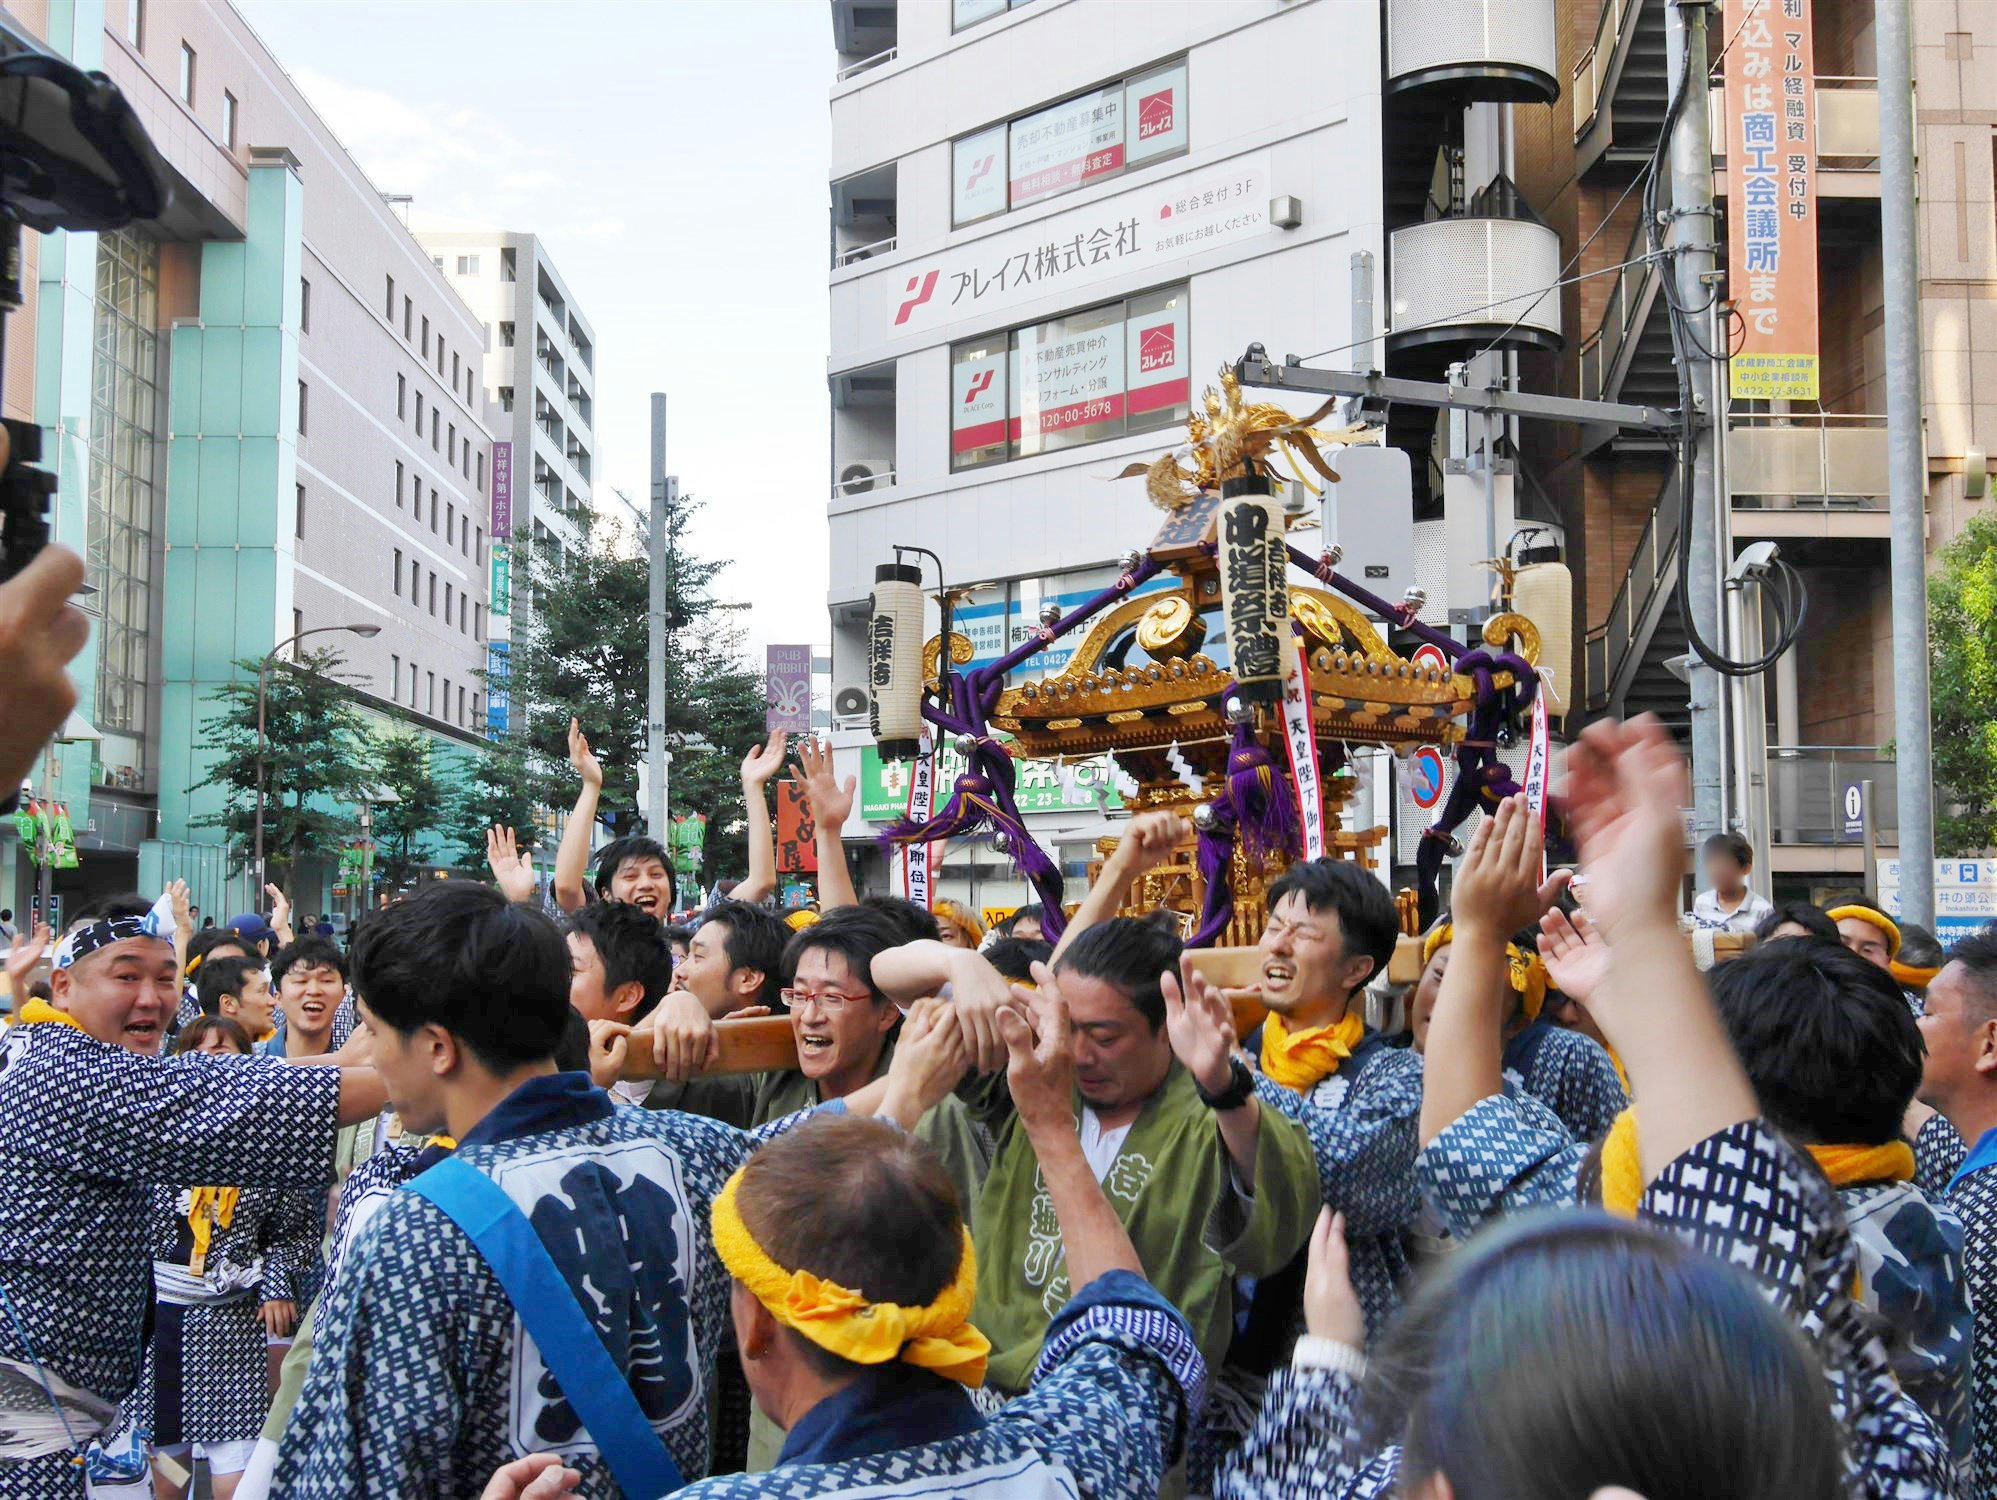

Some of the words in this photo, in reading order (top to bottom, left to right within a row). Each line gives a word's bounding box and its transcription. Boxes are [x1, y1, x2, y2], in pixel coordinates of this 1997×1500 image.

[1784, 32, 1806, 142] マル経融資
[1175, 186, 1229, 215] 総合受付
[1236, 179, 1253, 197] 3F
[1787, 155, 1807, 220] 受付中
[1155, 212, 1263, 252] お気軽にお越しください
[951, 217, 1141, 306] プレイス株式会社
[1037, 335, 1108, 363] 不動産売買仲介
[1141, 350, 1173, 369] プレイス
[1041, 402, 1111, 428] 120-00-5678
[496, 446, 508, 531] 吉祥寺第一ホテル
[768, 662, 809, 674] RABBIT
[777, 650, 801, 660] PUB
[873, 614, 894, 686] 吉祥寺
[1025, 658, 1041, 667] TEL
[863, 803, 891, 812] INAGAKI
[891, 802, 908, 811] PHAR
[909, 752, 930, 903] 天皇陛下即位三
